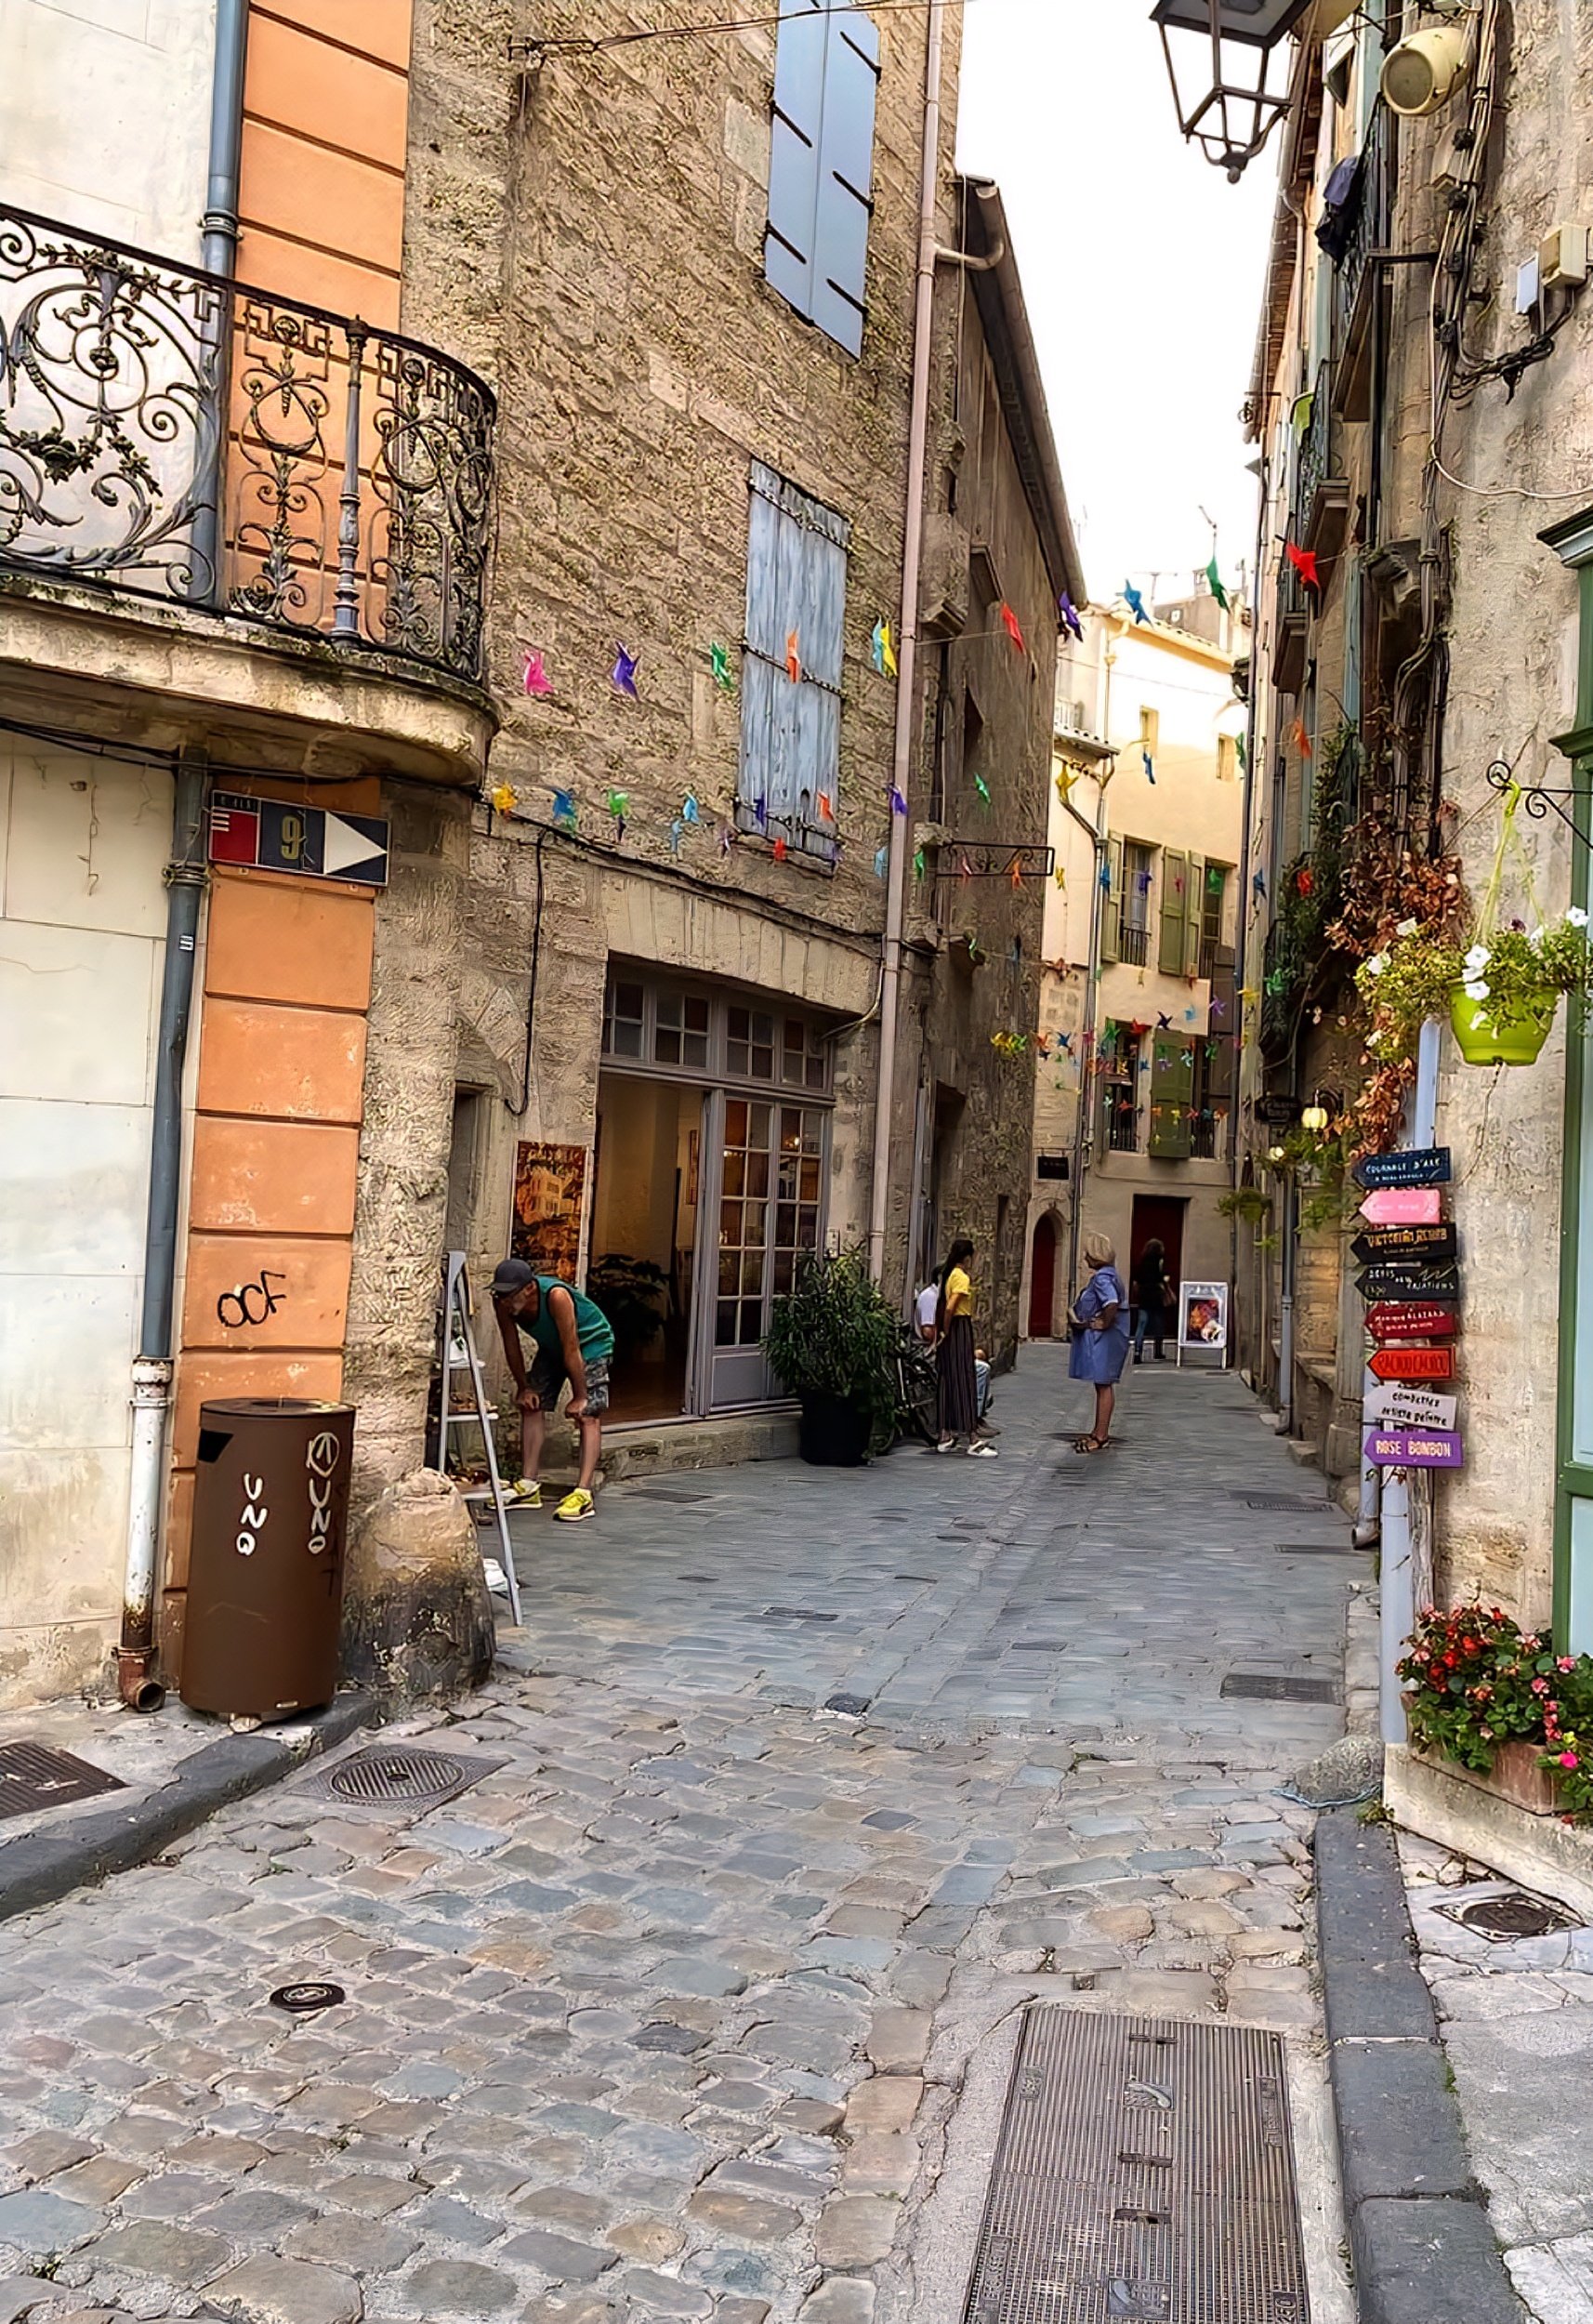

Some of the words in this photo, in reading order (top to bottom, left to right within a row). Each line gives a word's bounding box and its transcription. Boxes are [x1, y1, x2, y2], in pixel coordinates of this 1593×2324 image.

[281, 814, 301, 861] 9
[217, 1269, 286, 1328] OCF
[1376, 1439, 1402, 1456] ROSE
[1407, 1439, 1452, 1457] BONBON
